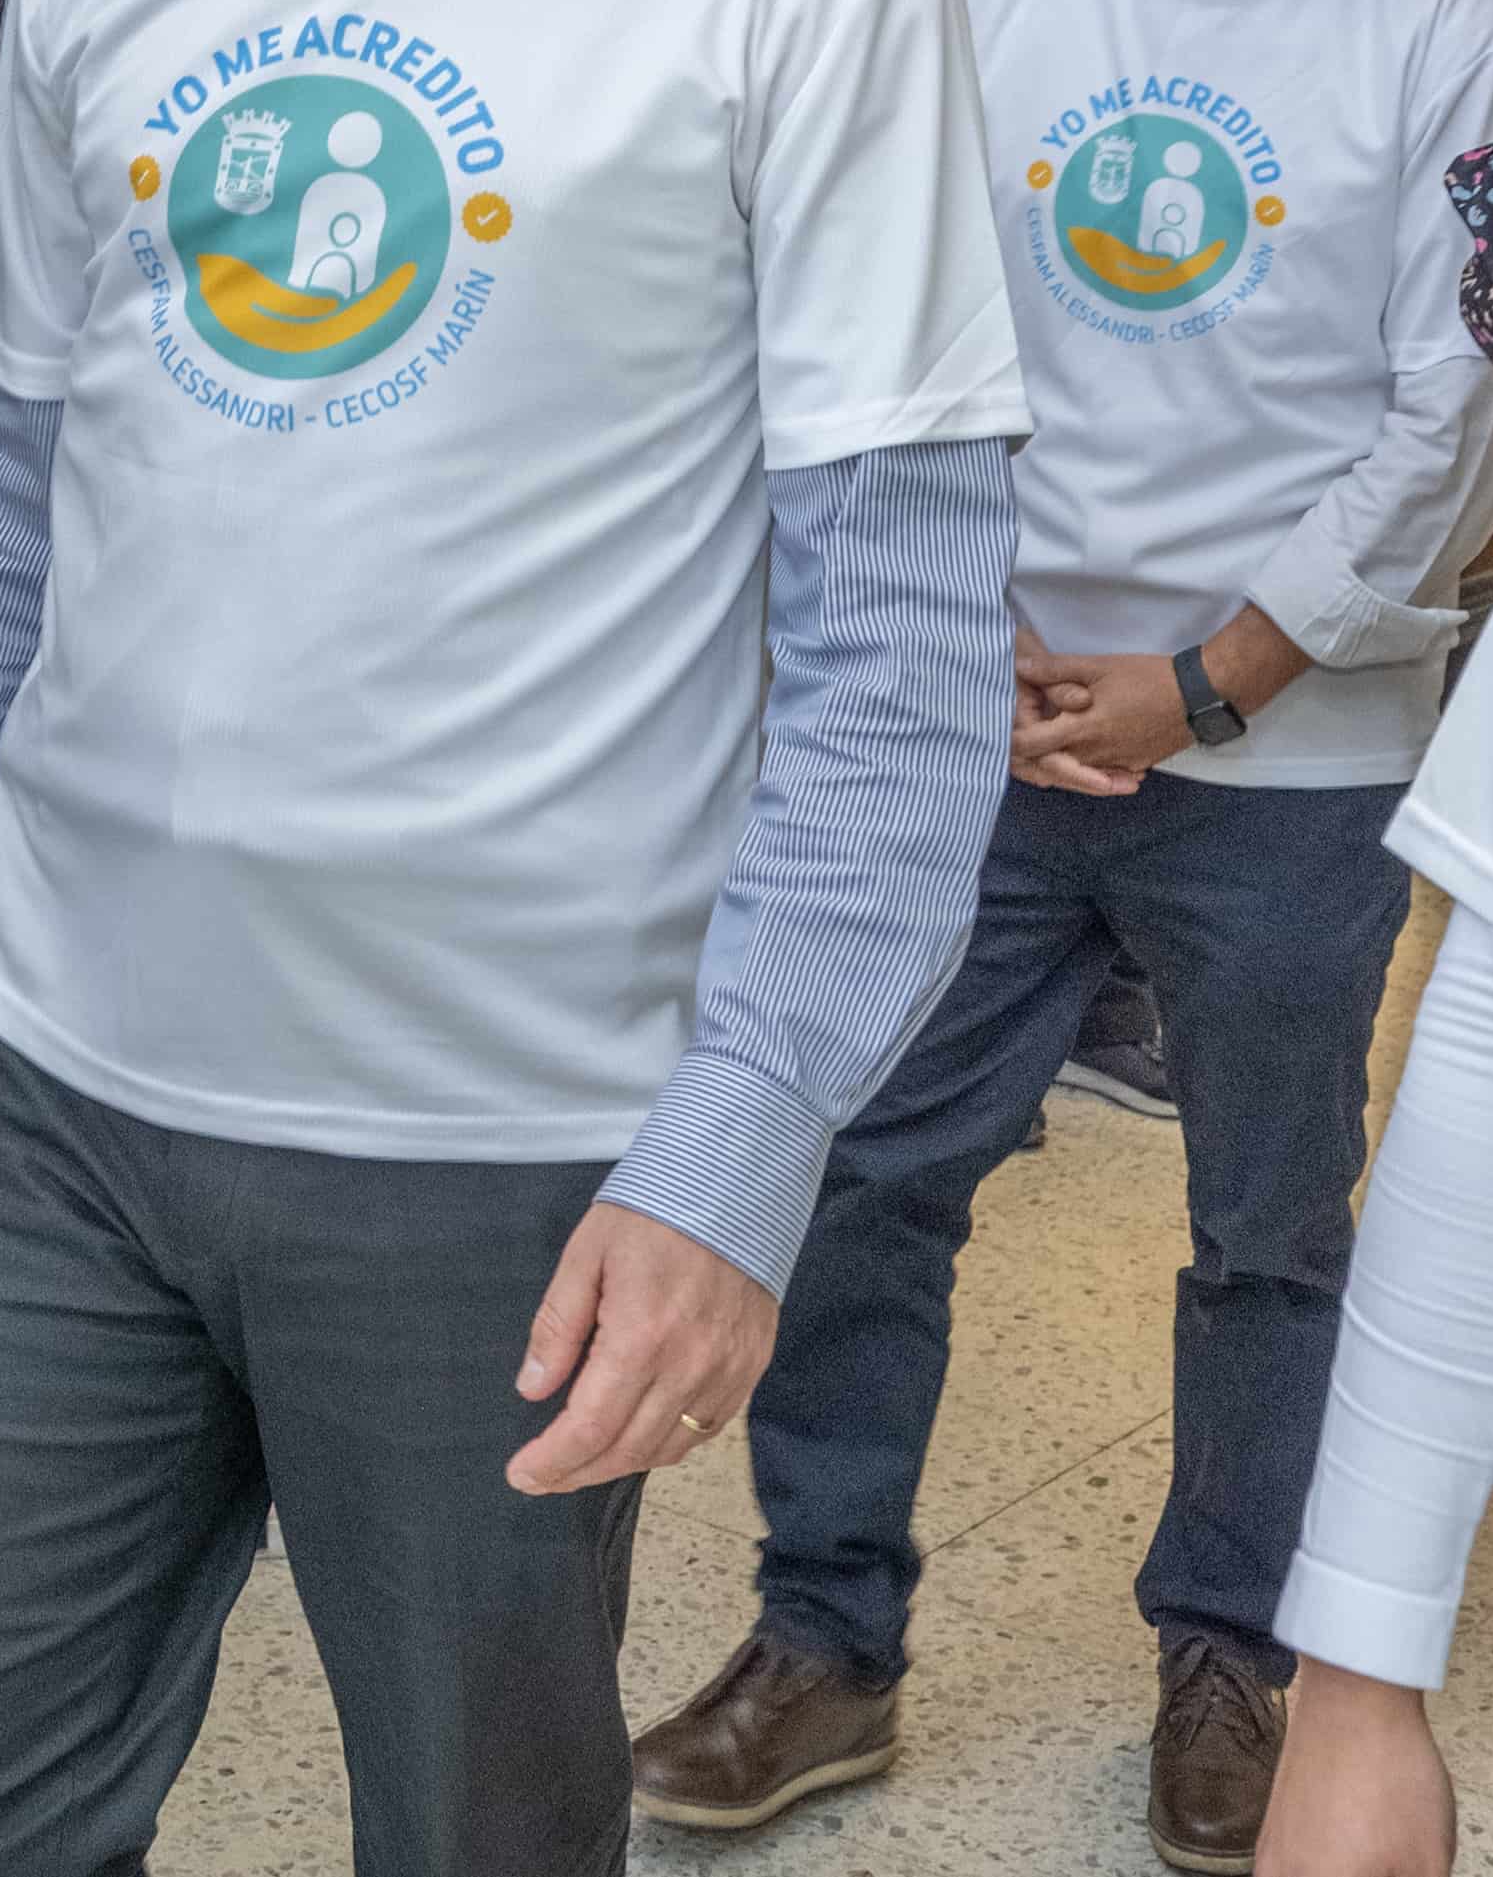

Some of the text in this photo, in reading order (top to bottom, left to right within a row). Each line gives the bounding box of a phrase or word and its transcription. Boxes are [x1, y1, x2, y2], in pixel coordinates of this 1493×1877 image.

[145, 12, 505, 175] YO ME ACREDITO
[1040, 75, 1282, 185] YO ME ACREDITO
[127, 228, 169, 336] CESFAM
[154, 334, 294, 432] ALESSANDRI
[326, 357, 429, 430] CECOSF
[425, 267, 496, 366] MARÍN
[1048, 280, 1156, 345] ALESSANDRI
